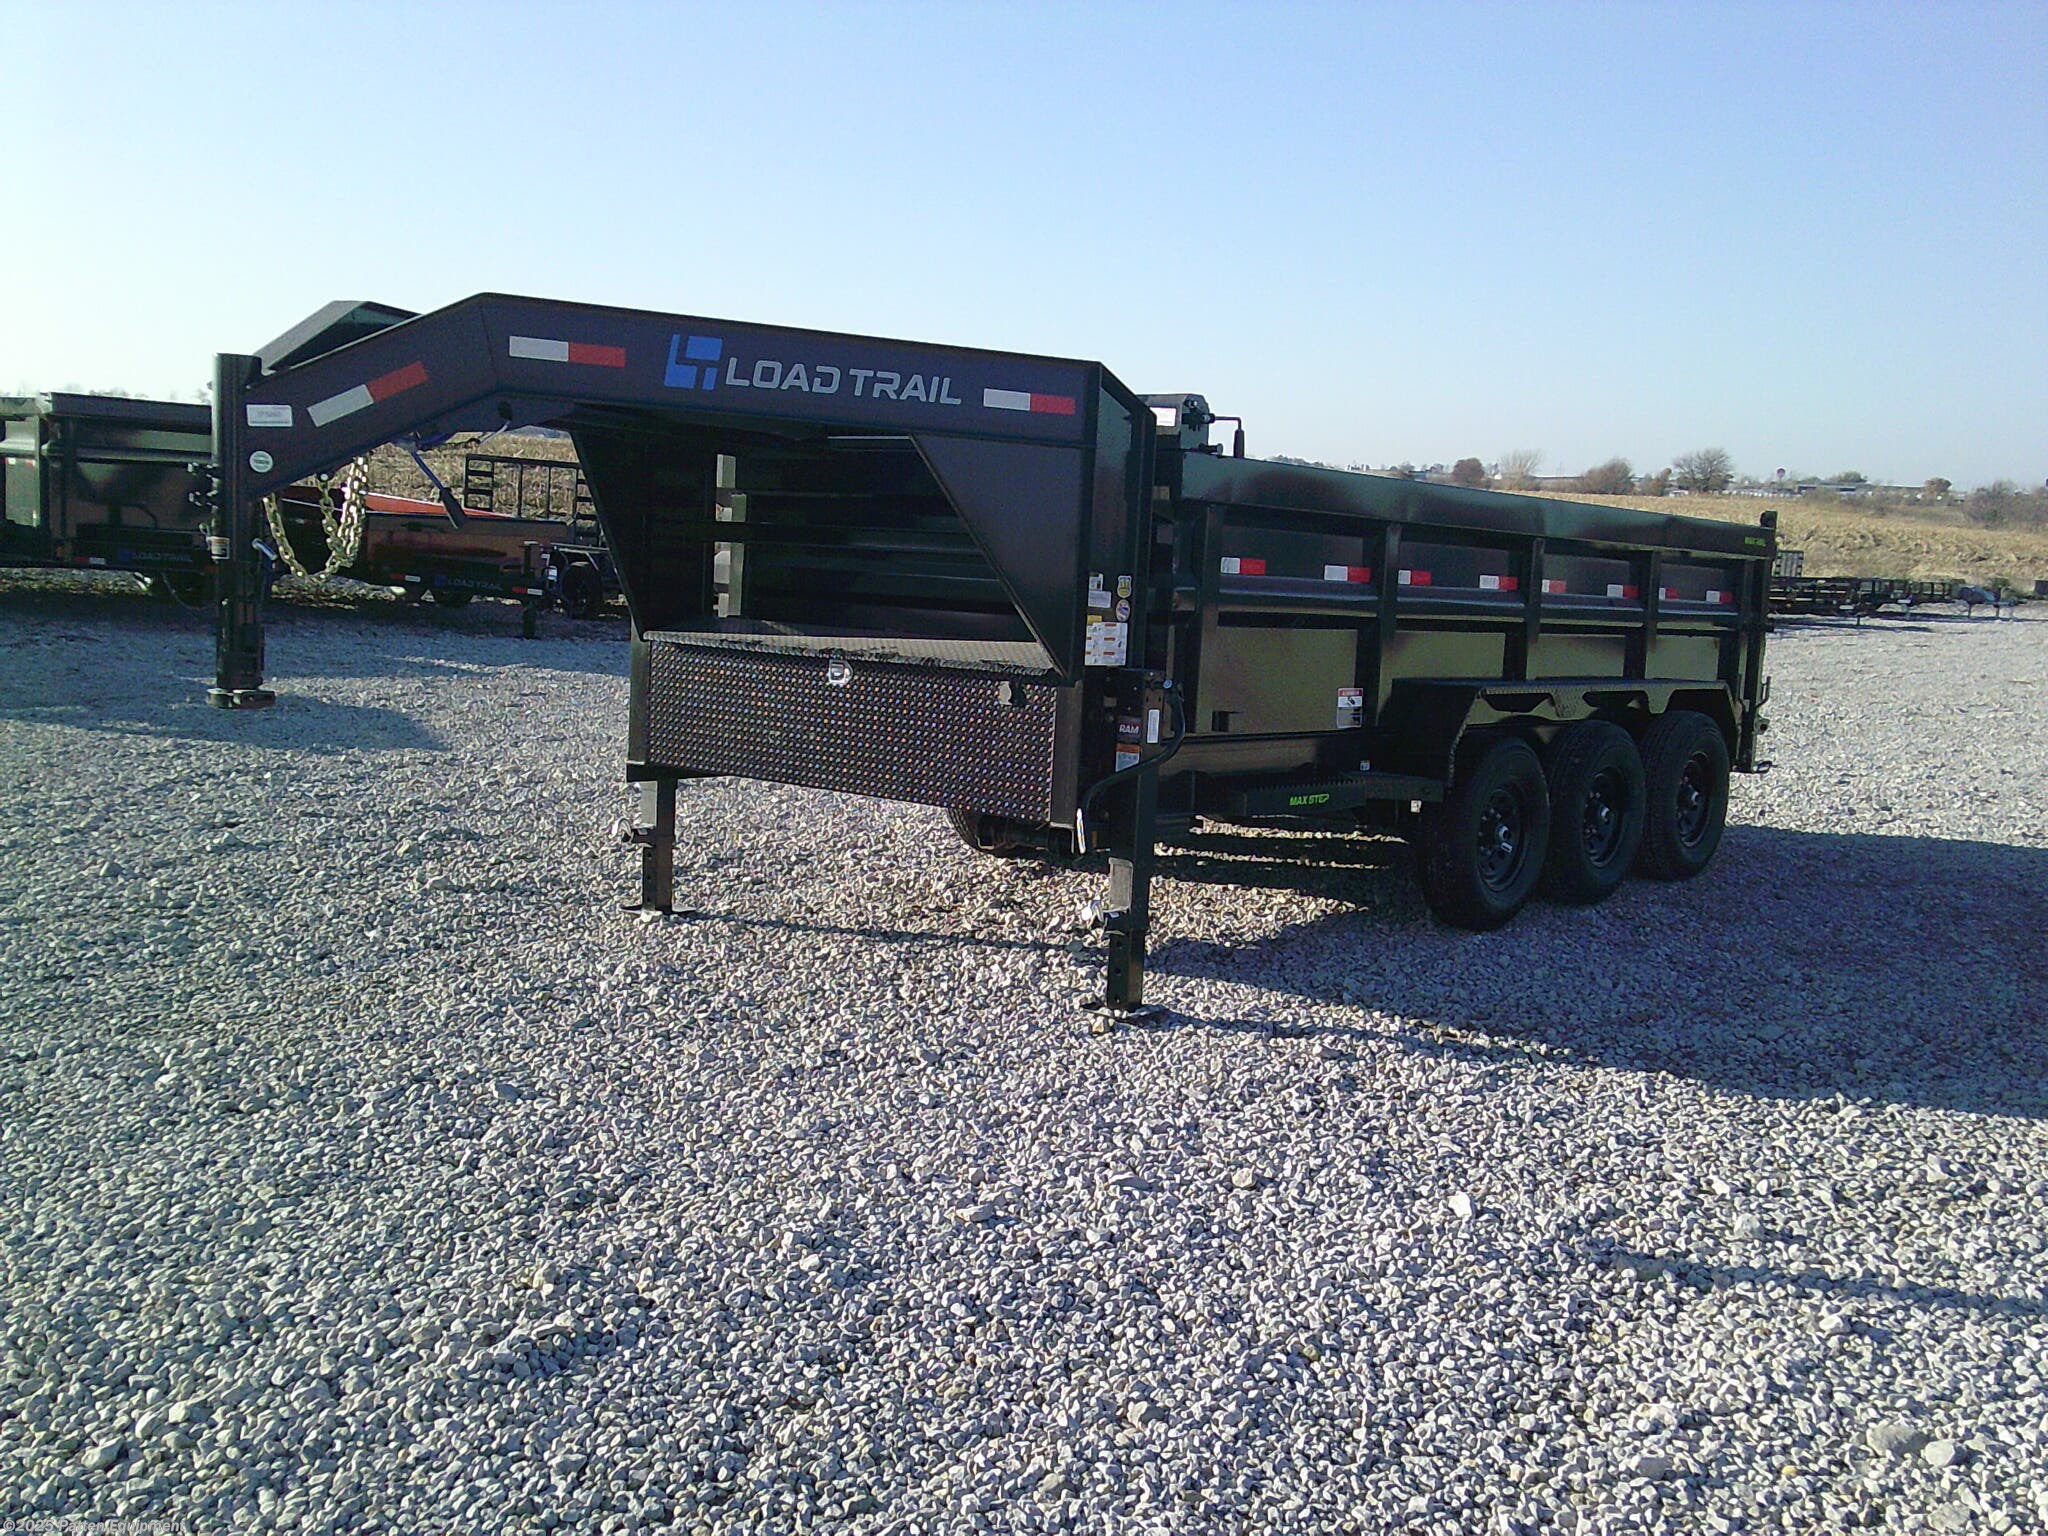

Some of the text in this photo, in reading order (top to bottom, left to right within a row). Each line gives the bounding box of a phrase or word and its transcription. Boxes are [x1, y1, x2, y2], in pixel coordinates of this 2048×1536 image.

[725, 357, 962, 405] LOAD TRAIL
[1119, 723, 1140, 734] RAM
[1289, 795, 1308, 806] MAX
